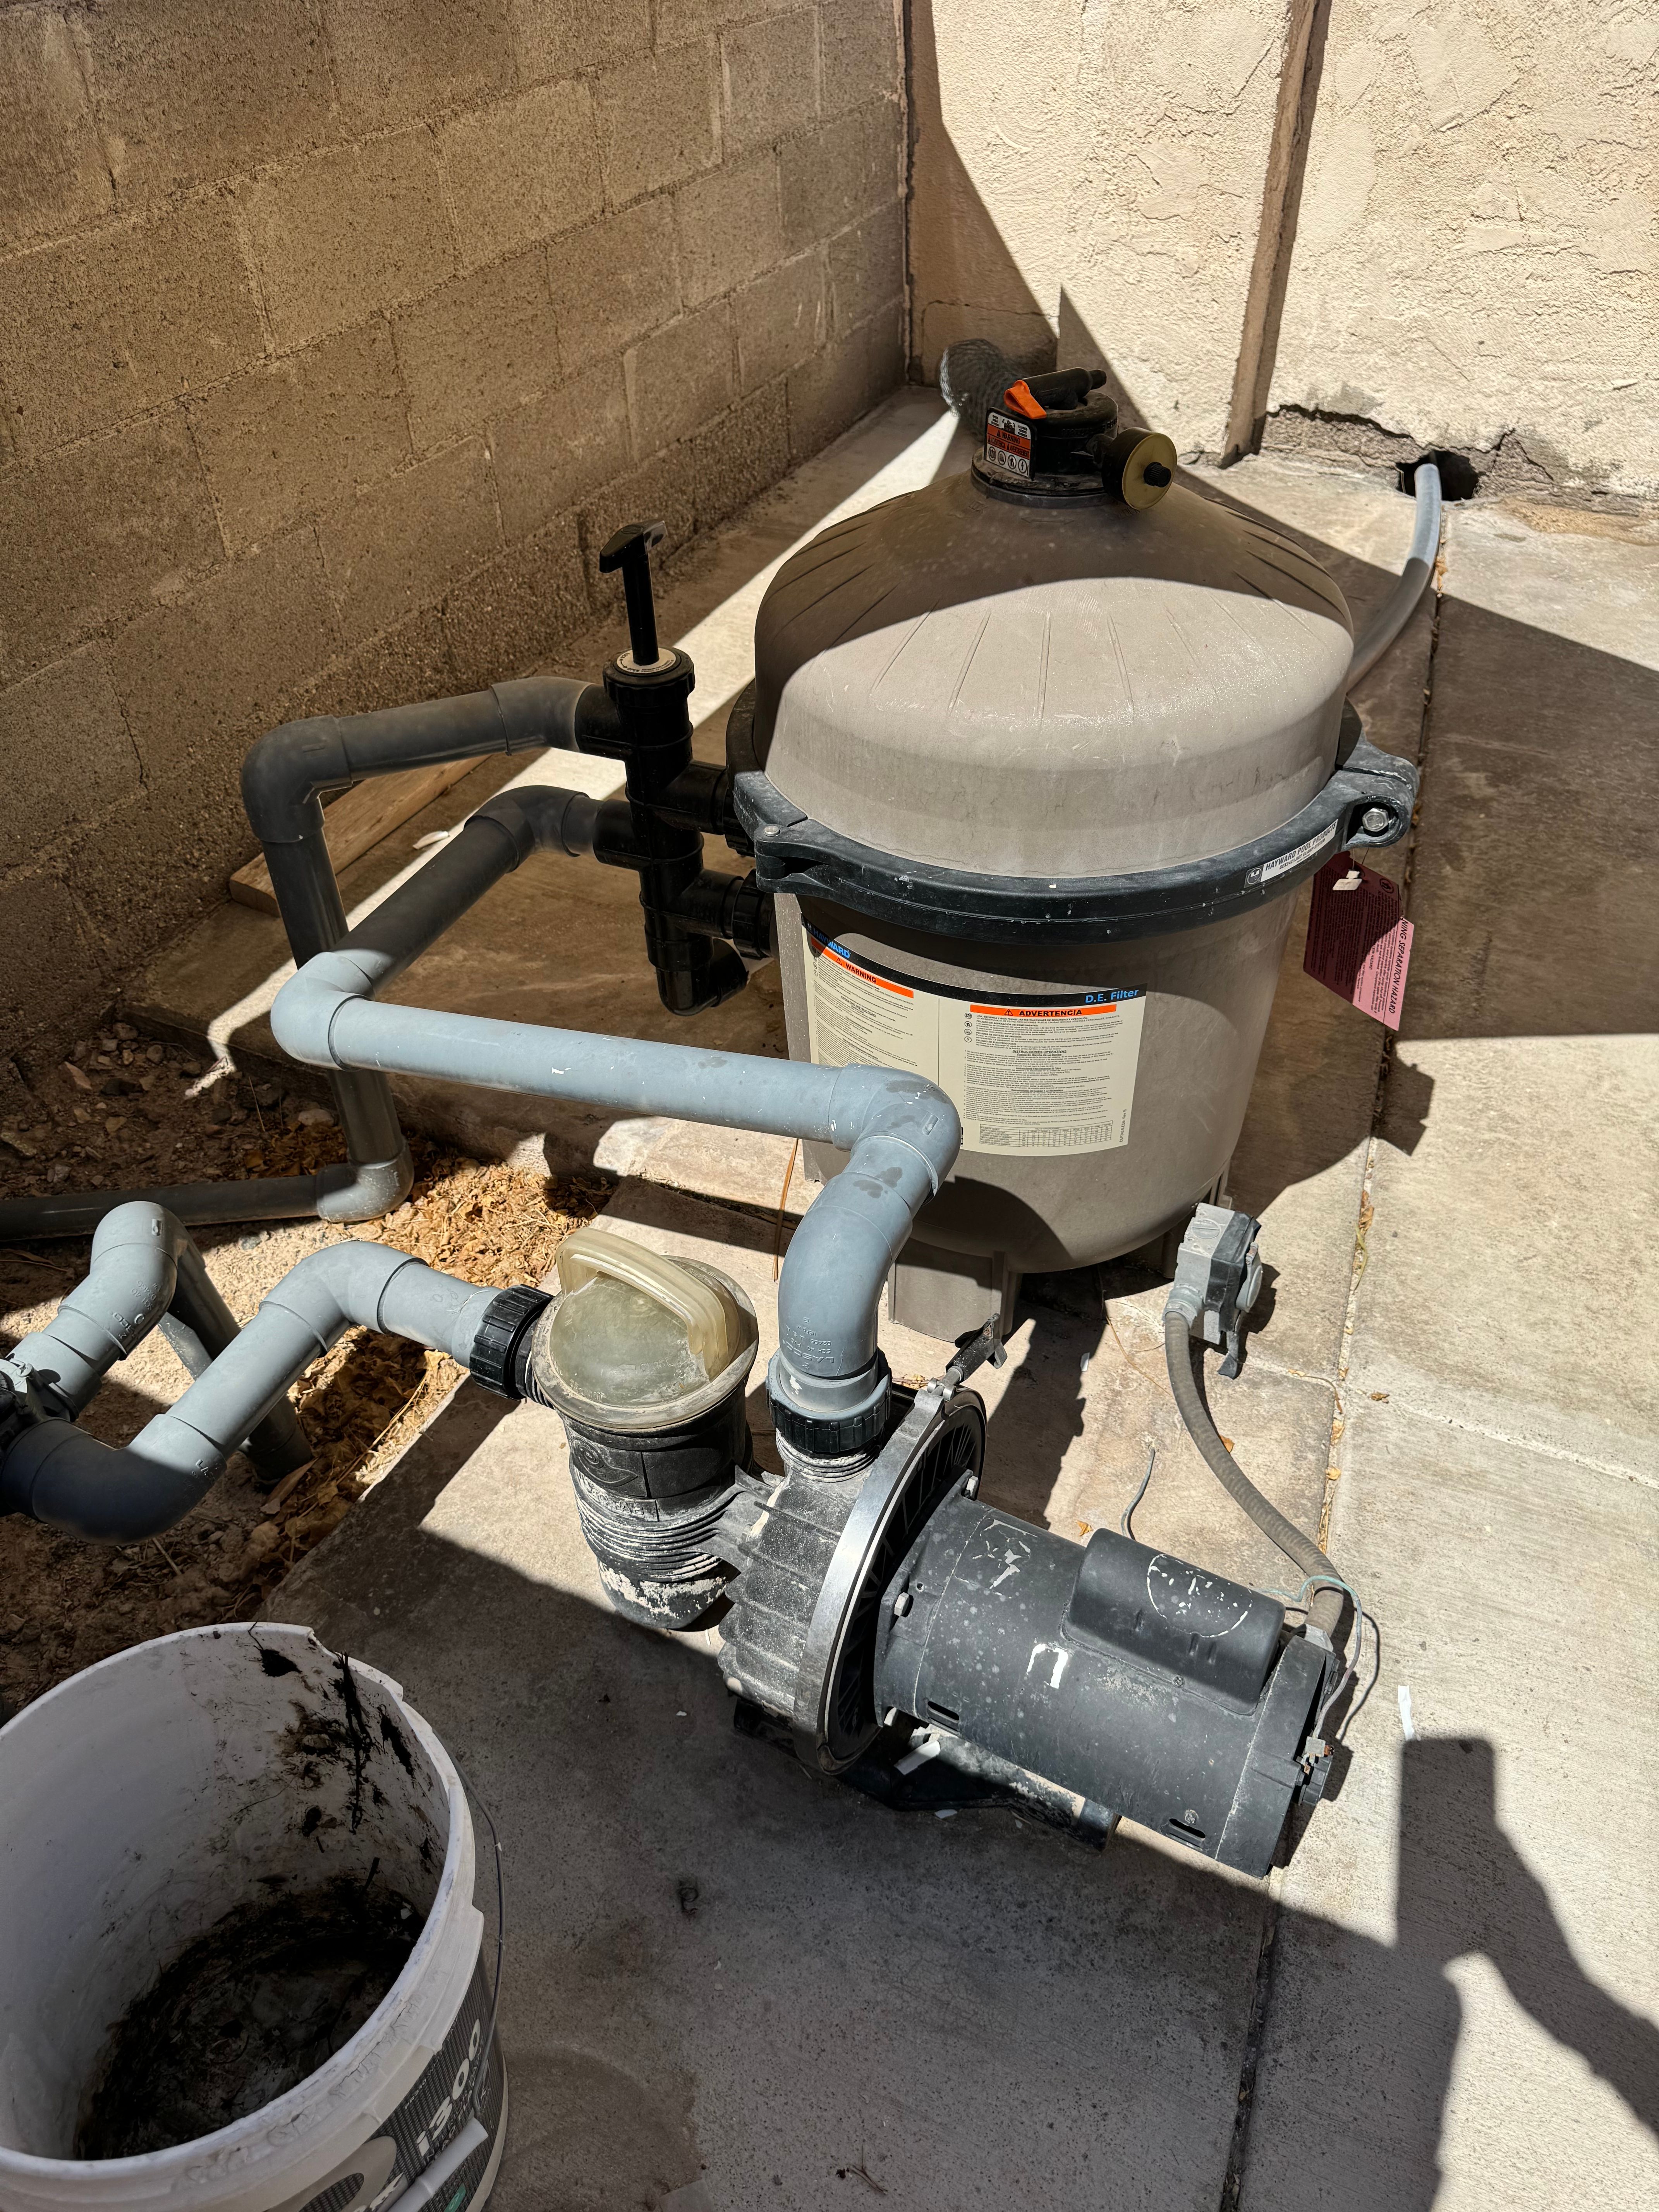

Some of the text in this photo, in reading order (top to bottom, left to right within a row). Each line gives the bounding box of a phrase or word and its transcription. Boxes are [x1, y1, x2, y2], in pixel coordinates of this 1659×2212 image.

[1265, 850, 1296, 871] HAYWARD
[1297, 842, 1311, 855] POOL
[1312, 821, 1336, 845] PRODUCTS
[813, 931, 851, 958] HAYWARD
[846, 962, 876, 983] WARNING
[1389, 918, 1408, 1013] NING SEPARATION HAZARD
[1085, 989, 1139, 1003] D.E. Filter
